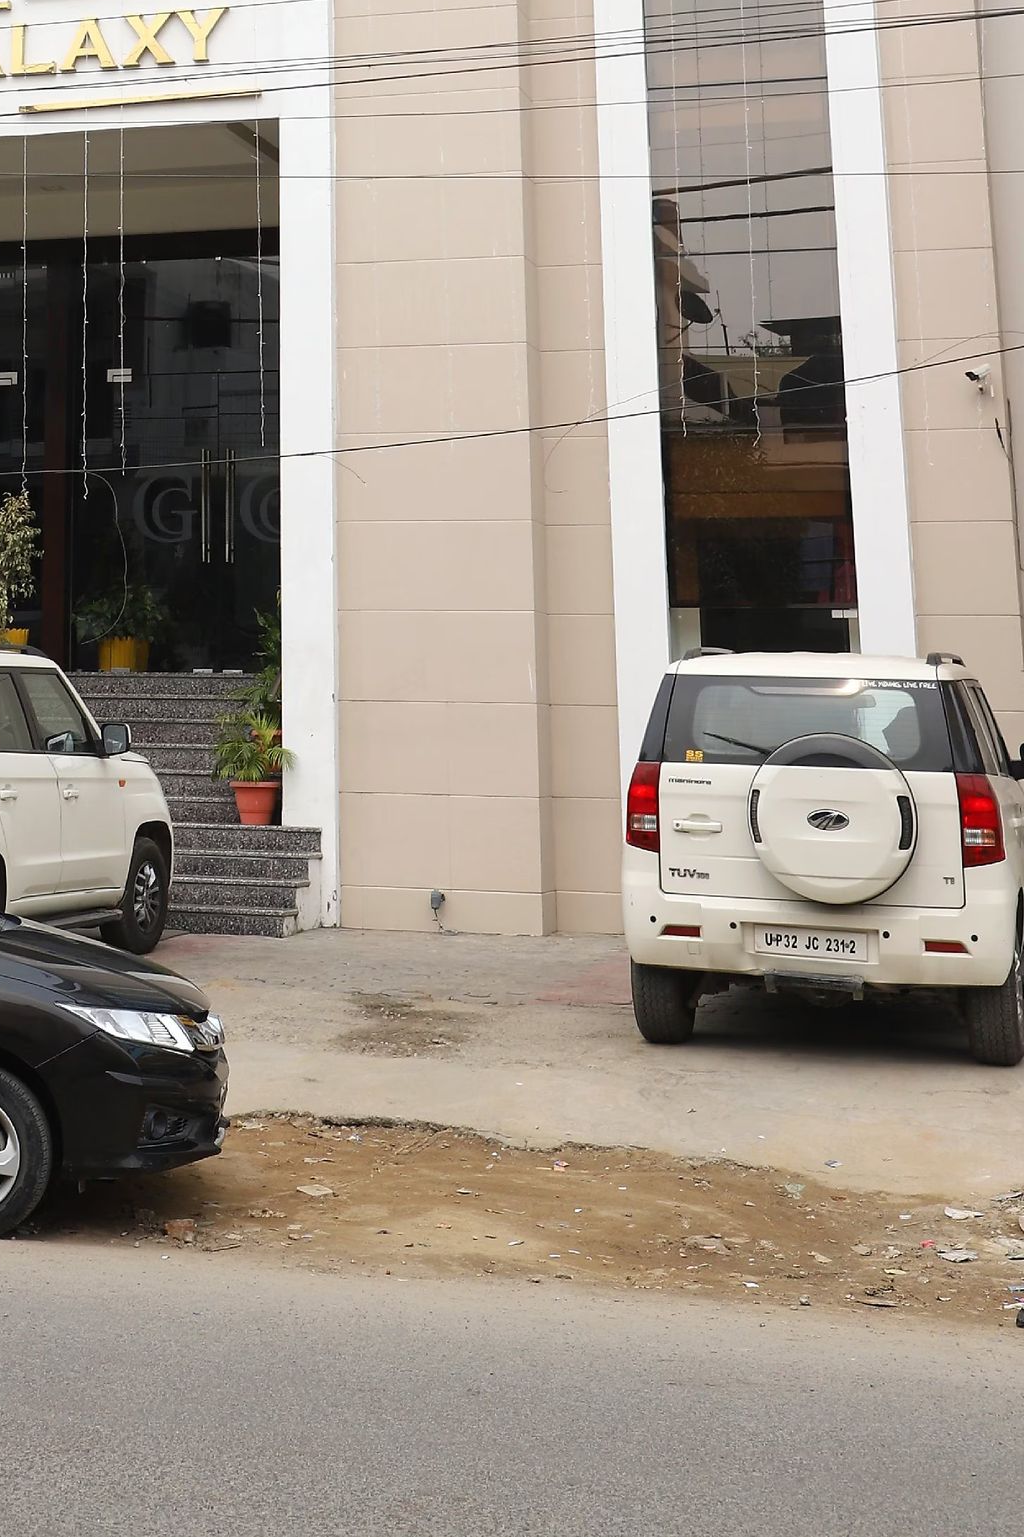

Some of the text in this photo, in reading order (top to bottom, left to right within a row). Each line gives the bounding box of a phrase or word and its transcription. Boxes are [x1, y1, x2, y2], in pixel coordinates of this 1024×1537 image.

[765, 932, 856, 954] UP32 JC 2312
